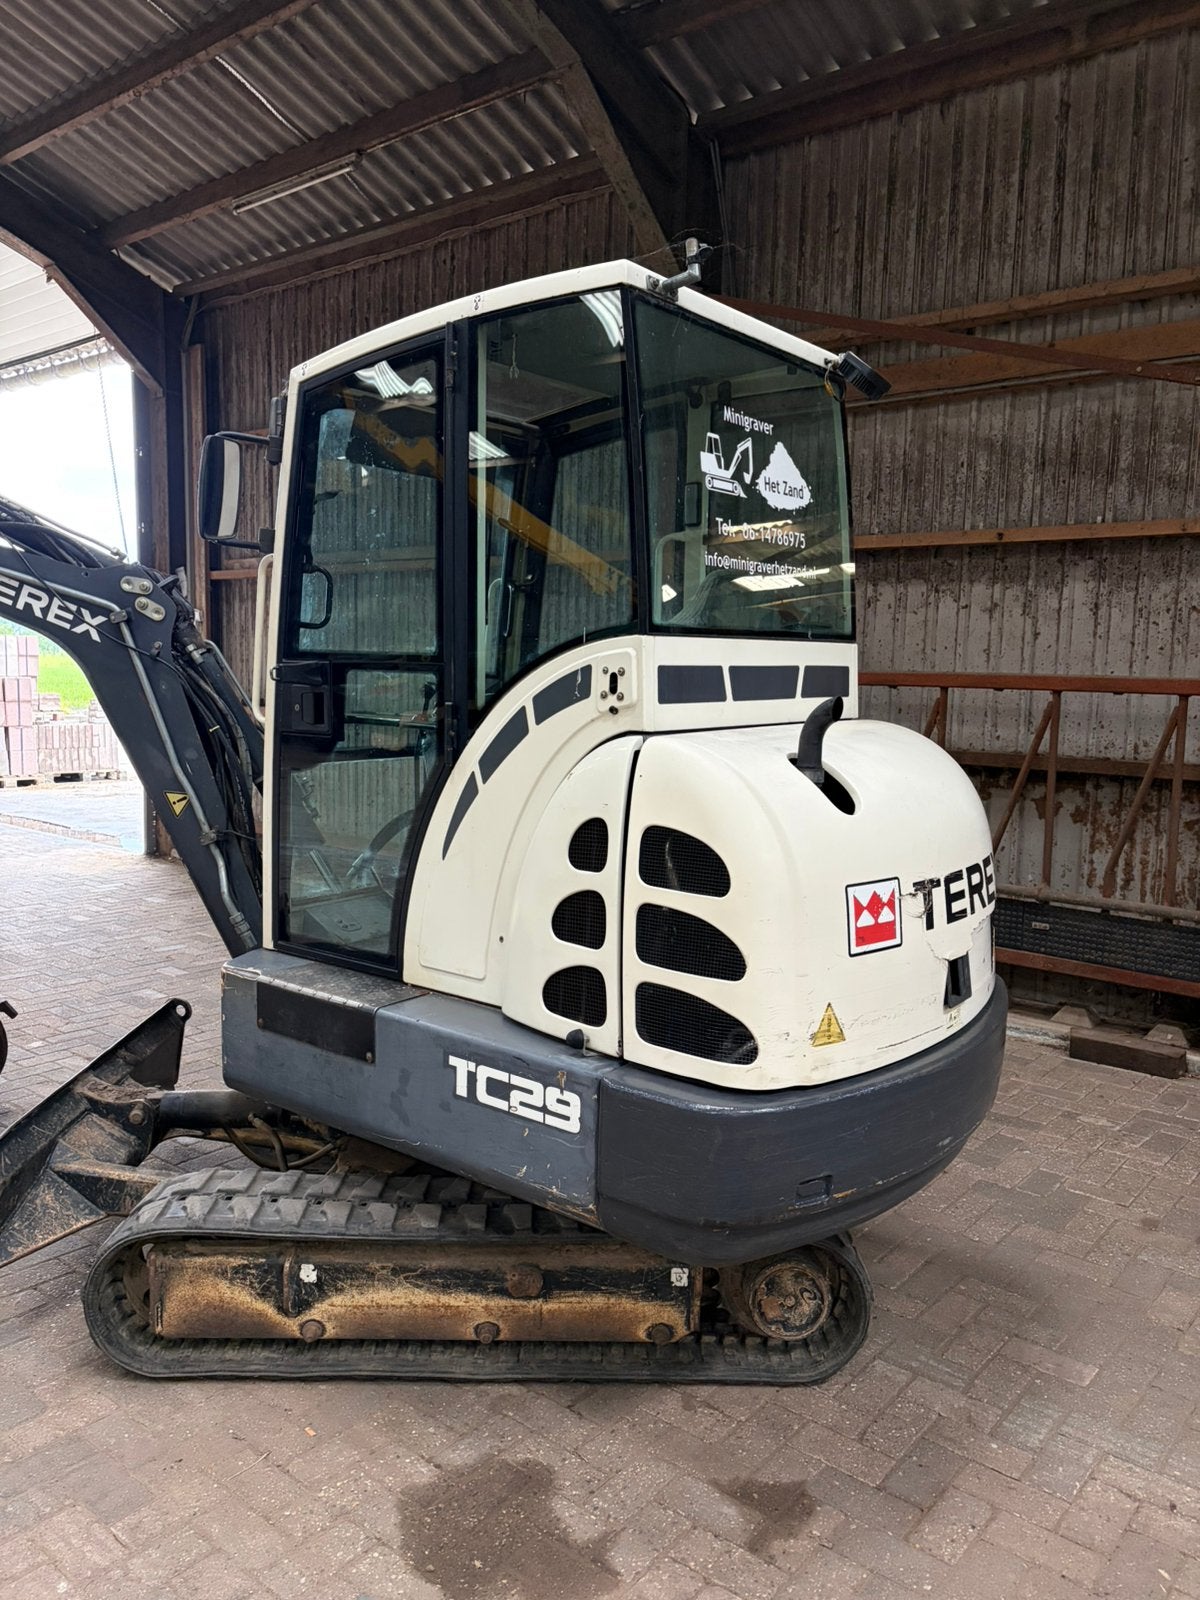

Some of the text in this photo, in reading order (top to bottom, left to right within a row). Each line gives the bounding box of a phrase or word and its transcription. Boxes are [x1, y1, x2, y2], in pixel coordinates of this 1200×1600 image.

[723, 405, 774, 436] Minigraver
[764, 476, 804, 499] Het Zand
[742, 522, 806, 549] 06-14786975
[705, 551, 817, 580] info@minigraverhetzand.nl
[912, 852, 995, 931] TERE
[448, 1054, 582, 1134] TC29
